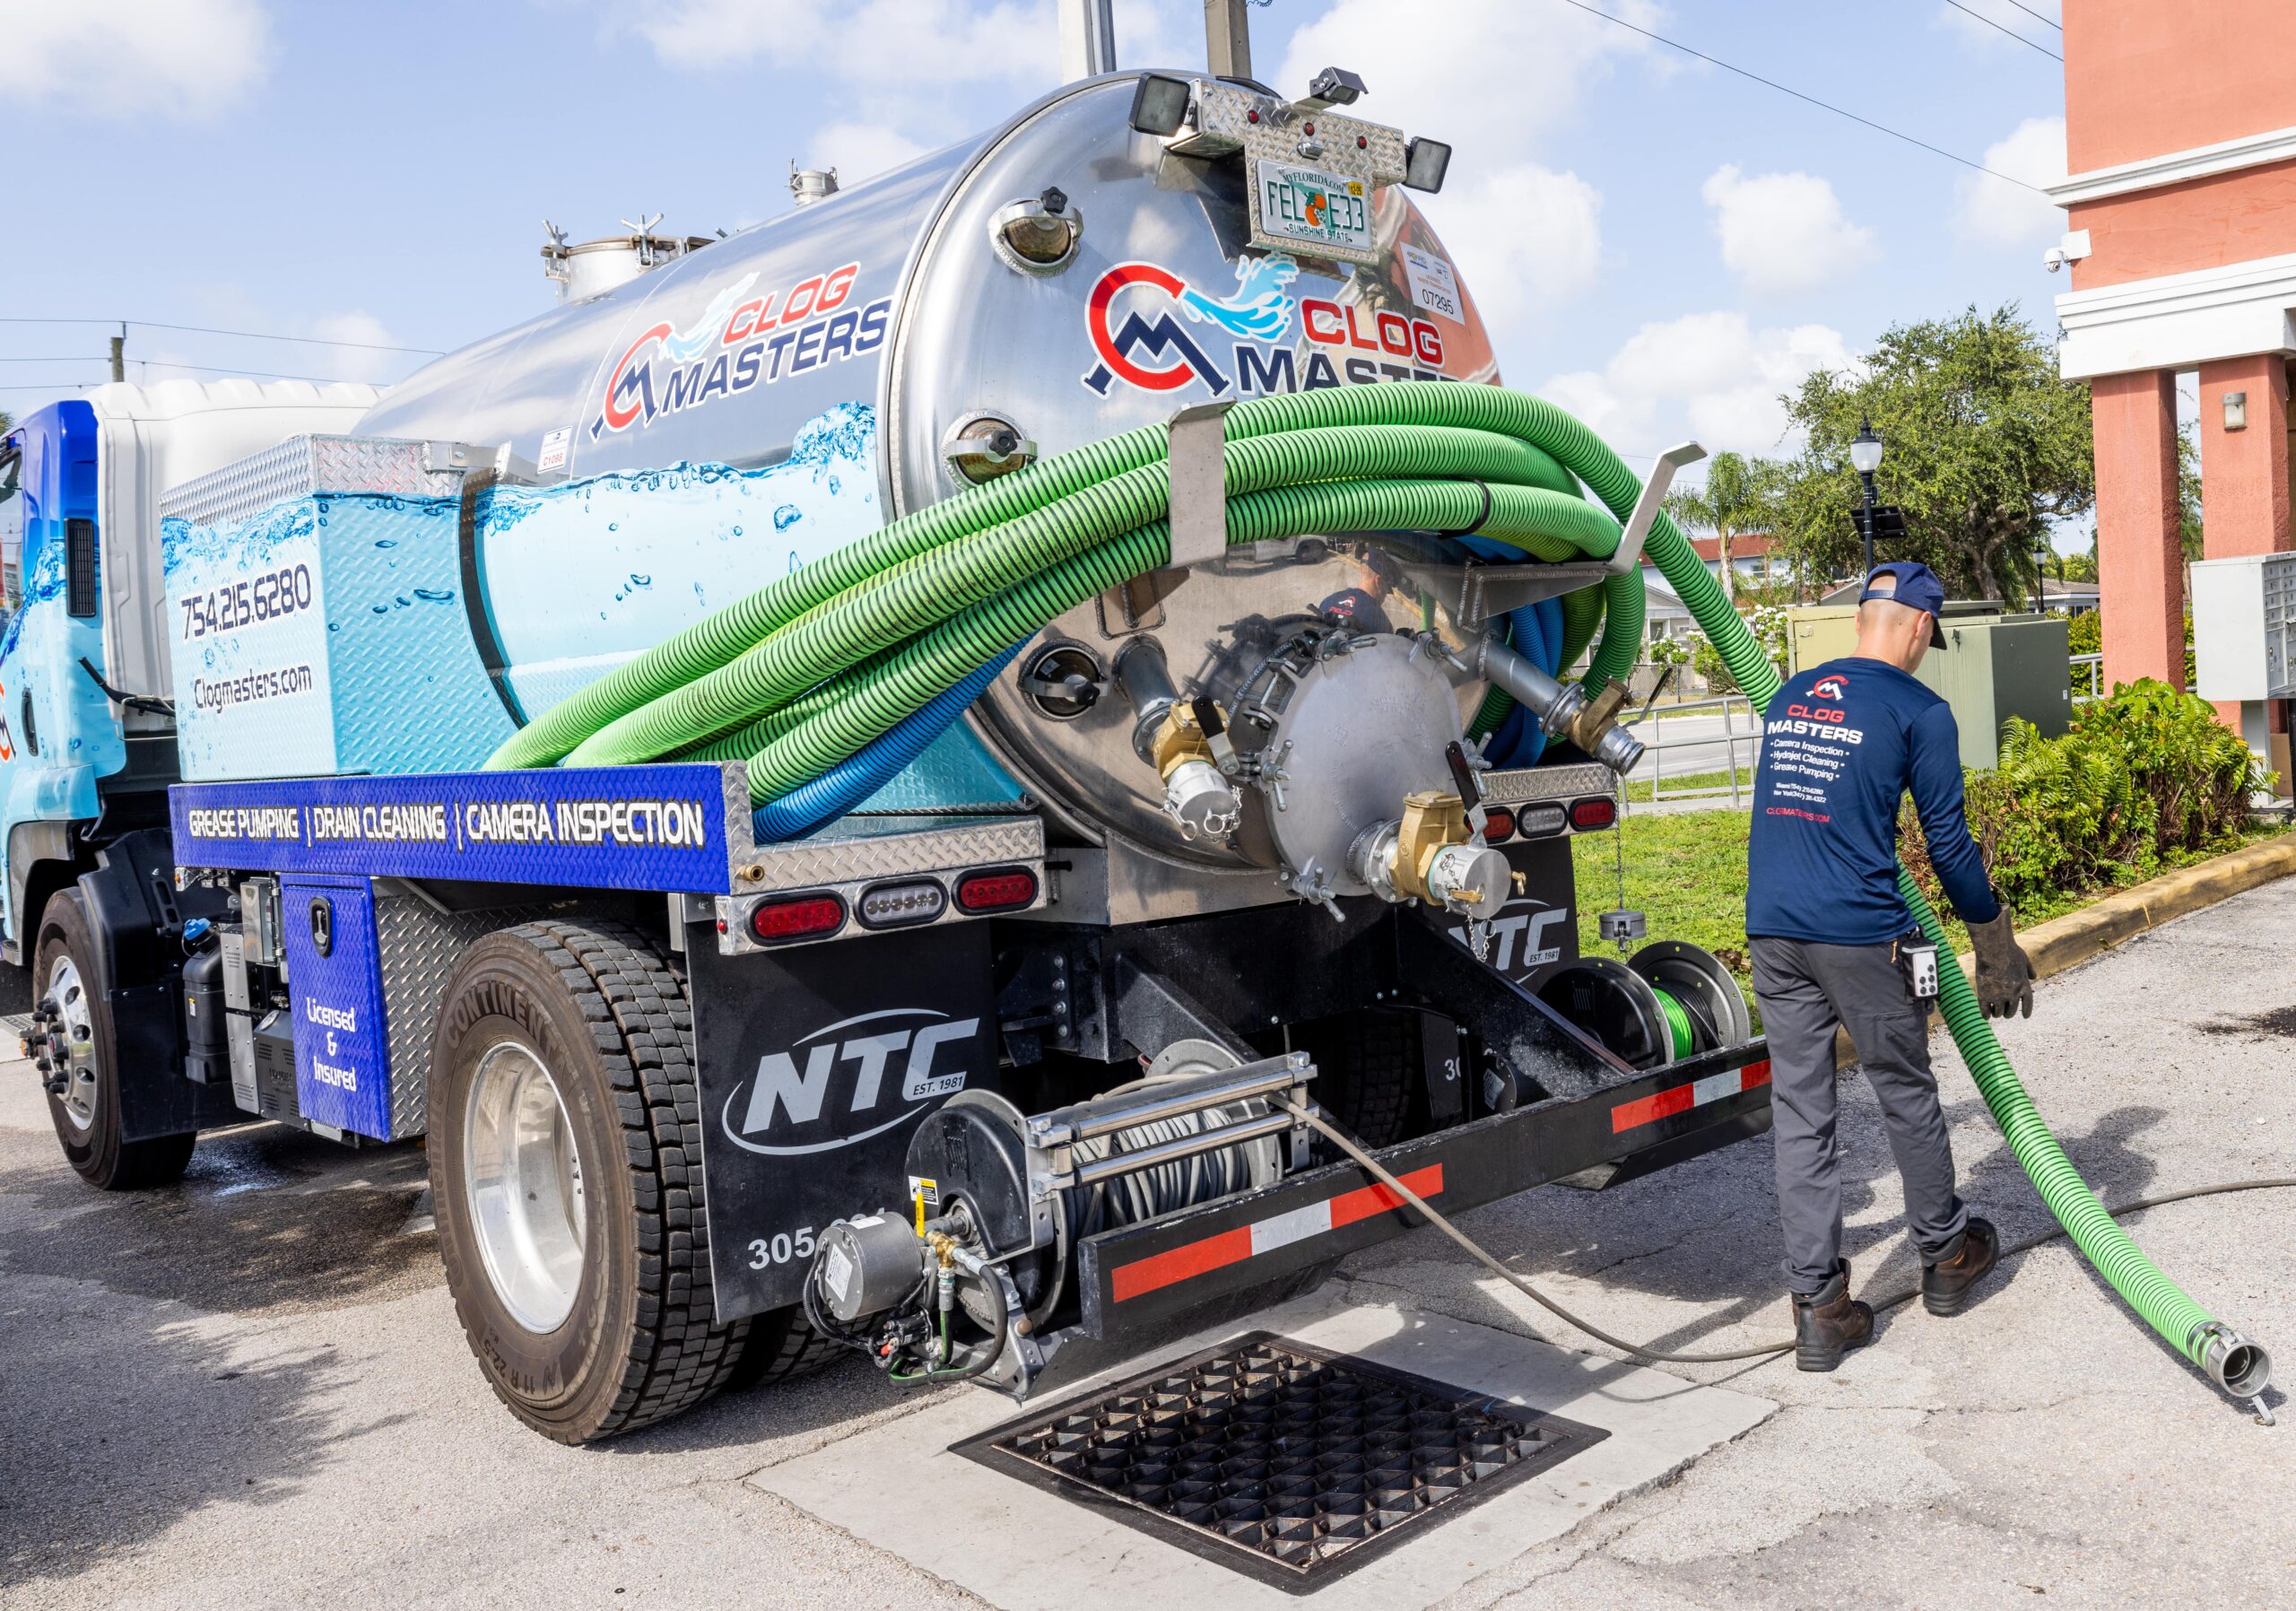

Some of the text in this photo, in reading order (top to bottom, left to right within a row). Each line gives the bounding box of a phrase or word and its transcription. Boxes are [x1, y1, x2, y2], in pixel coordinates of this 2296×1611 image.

[1282, 171, 1344, 194] MYFLORIDA.COM
[1266, 180, 1364, 232] FEL E33
[1288, 223, 1350, 243] SUNSHINE STATE
[722, 265, 858, 345] CLOG
[1422, 289, 1454, 315] 07295
[1301, 299, 1444, 365] CLOG
[662, 299, 892, 414] MASTERS
[181, 563, 312, 640] 754.215.6280
[194, 665, 312, 714] Clogmasters.com
[1787, 704, 1846, 723] CLOG
[1767, 719, 1864, 745] MASTERS
[1802, 741, 1844, 756] Inspection
[1798, 763, 1834, 781] Pumping
[1802, 753, 1839, 770] Cleaning
[188, 802, 704, 846] GREASE PUMPING DRAIN CLEANING CAMERA INSPECTION
[1529, 951, 1559, 963] EST. 1981
[306, 997, 356, 1032] Licensed
[313, 1055, 357, 1092] Insured
[742, 1017, 980, 1135] NTC
[912, 1075, 964, 1096] EST. 1981
[747, 1226, 815, 1270] 305
